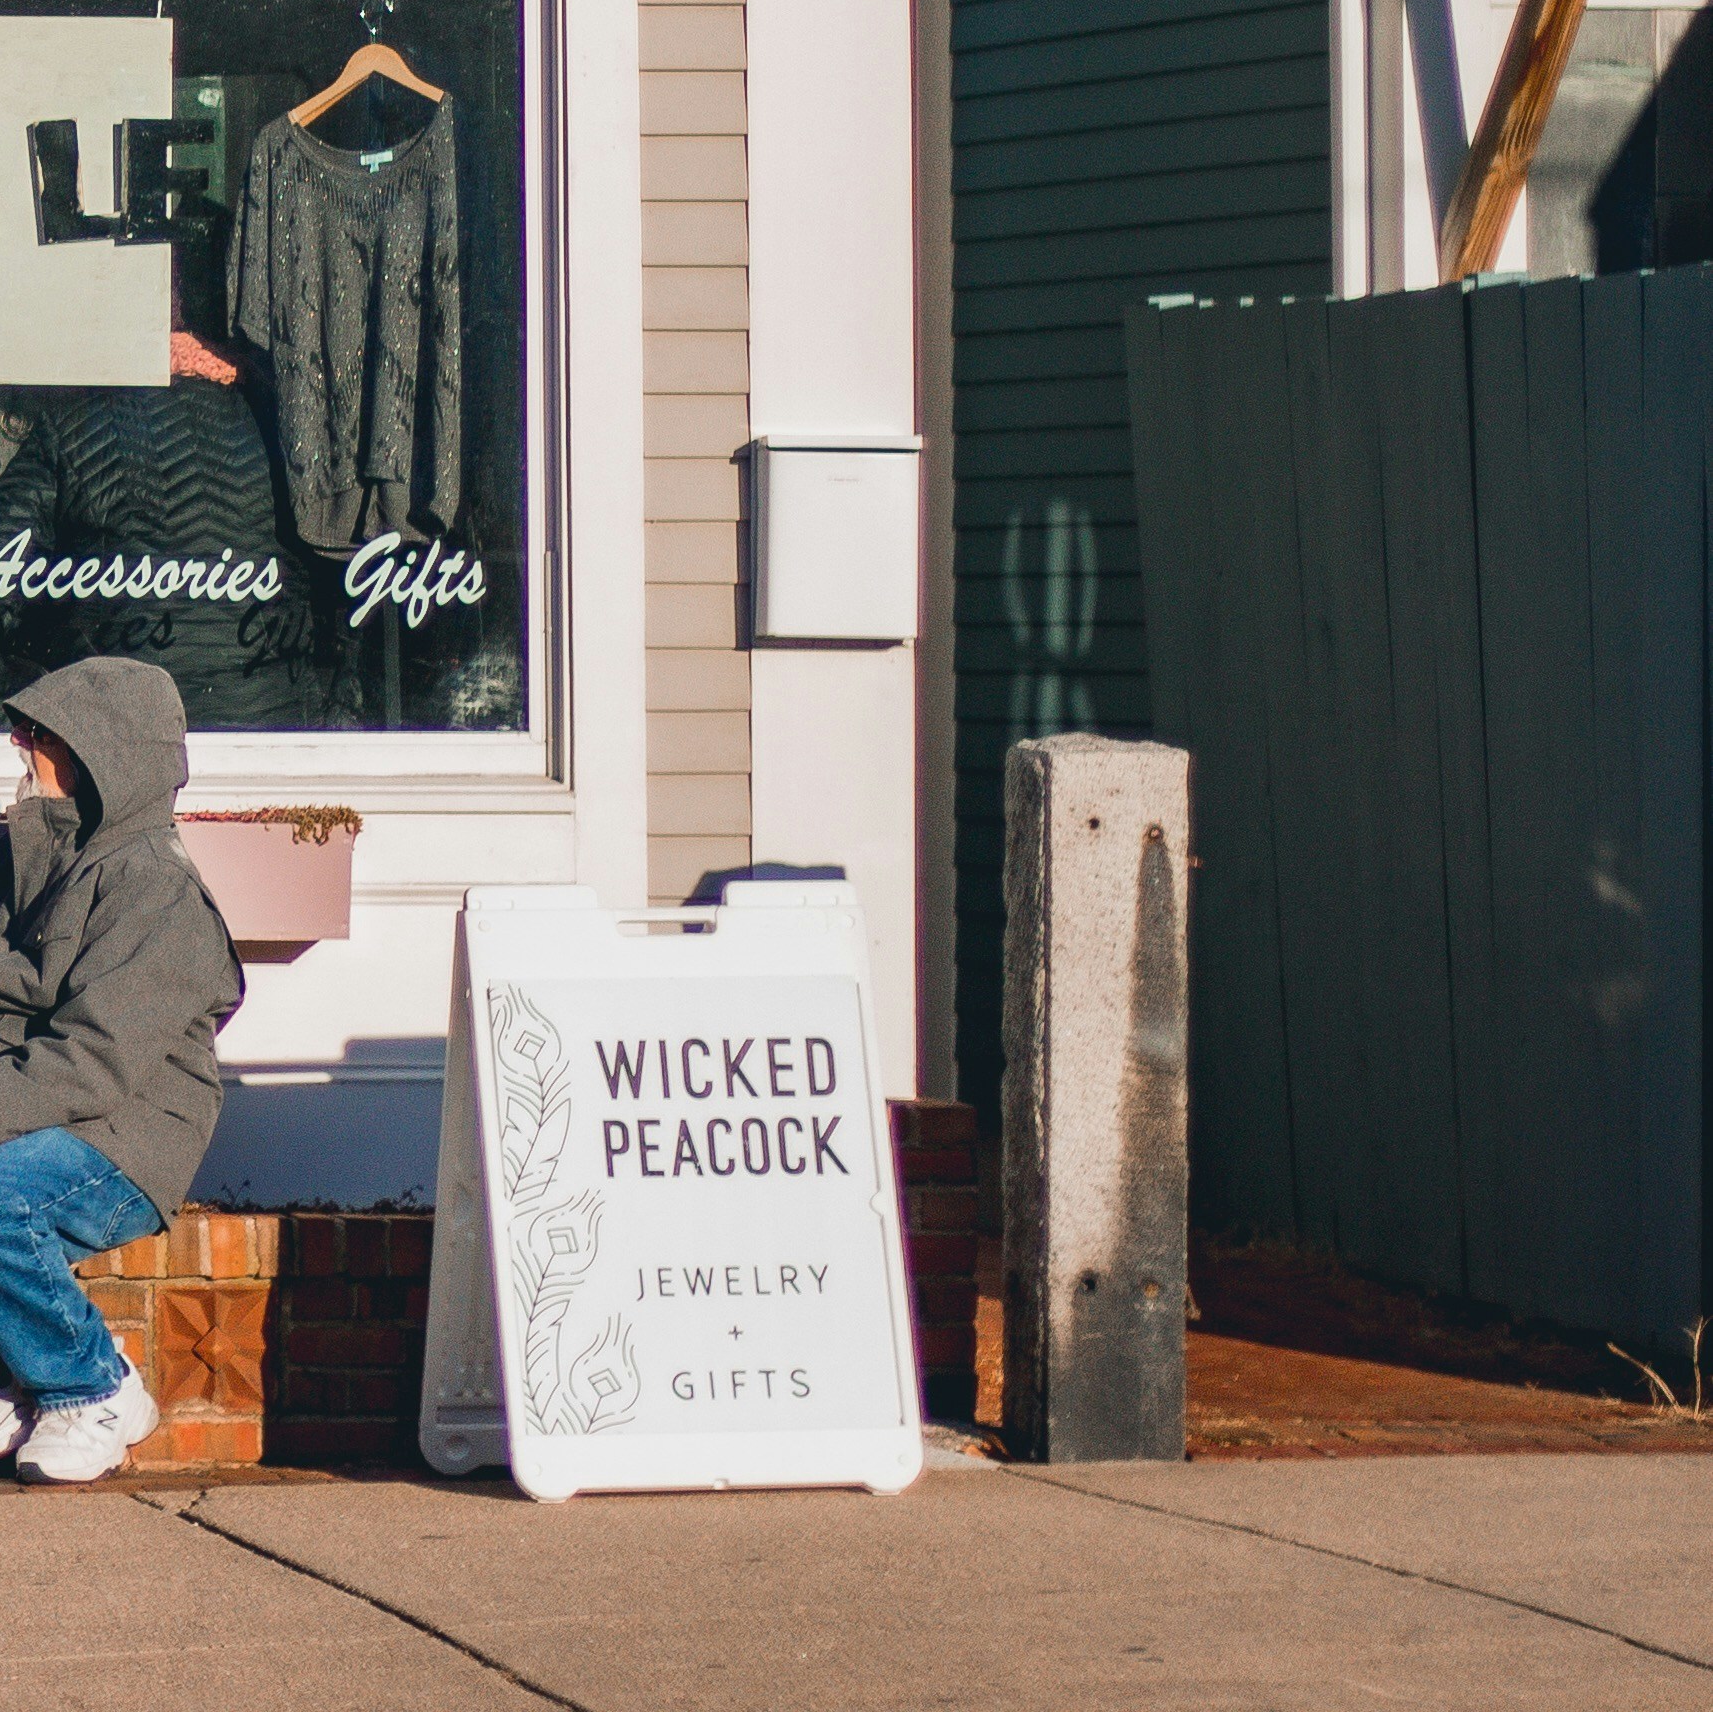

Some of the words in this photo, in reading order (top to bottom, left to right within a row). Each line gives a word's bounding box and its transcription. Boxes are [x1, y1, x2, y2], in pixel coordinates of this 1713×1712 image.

[343, 530, 487, 629] Gifts
[595, 1037, 838, 1099] WICKED
[602, 1116, 850, 1177] PEACOCK
[636, 1264, 831, 1302] JEWELRY
[671, 1369, 811, 1401] GIFTS
